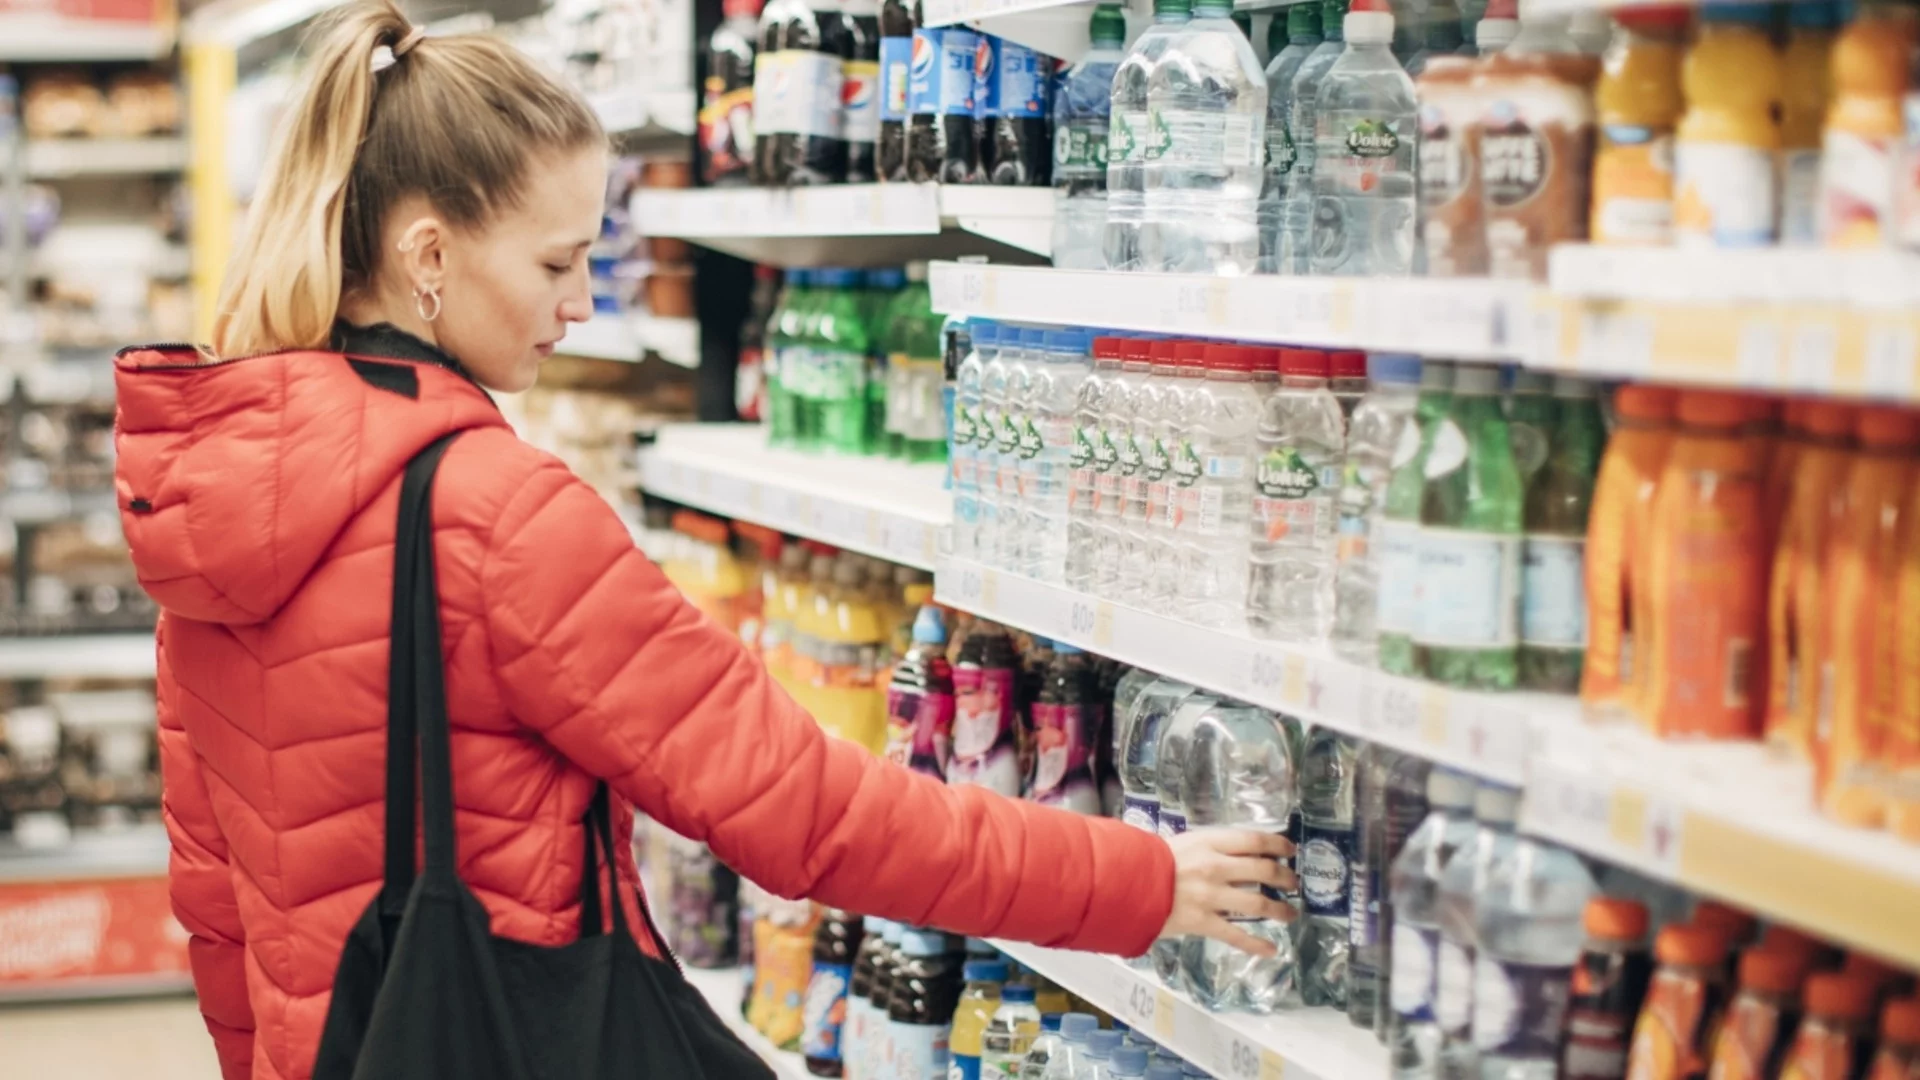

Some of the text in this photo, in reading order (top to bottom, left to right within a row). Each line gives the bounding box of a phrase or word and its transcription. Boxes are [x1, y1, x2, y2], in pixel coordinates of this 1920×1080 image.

[1350, 131, 1397, 148] Volvic
[1257, 463, 1315, 487] Volvic
[1071, 602, 1095, 634] 80p
[1128, 982, 1155, 1018] 42p
